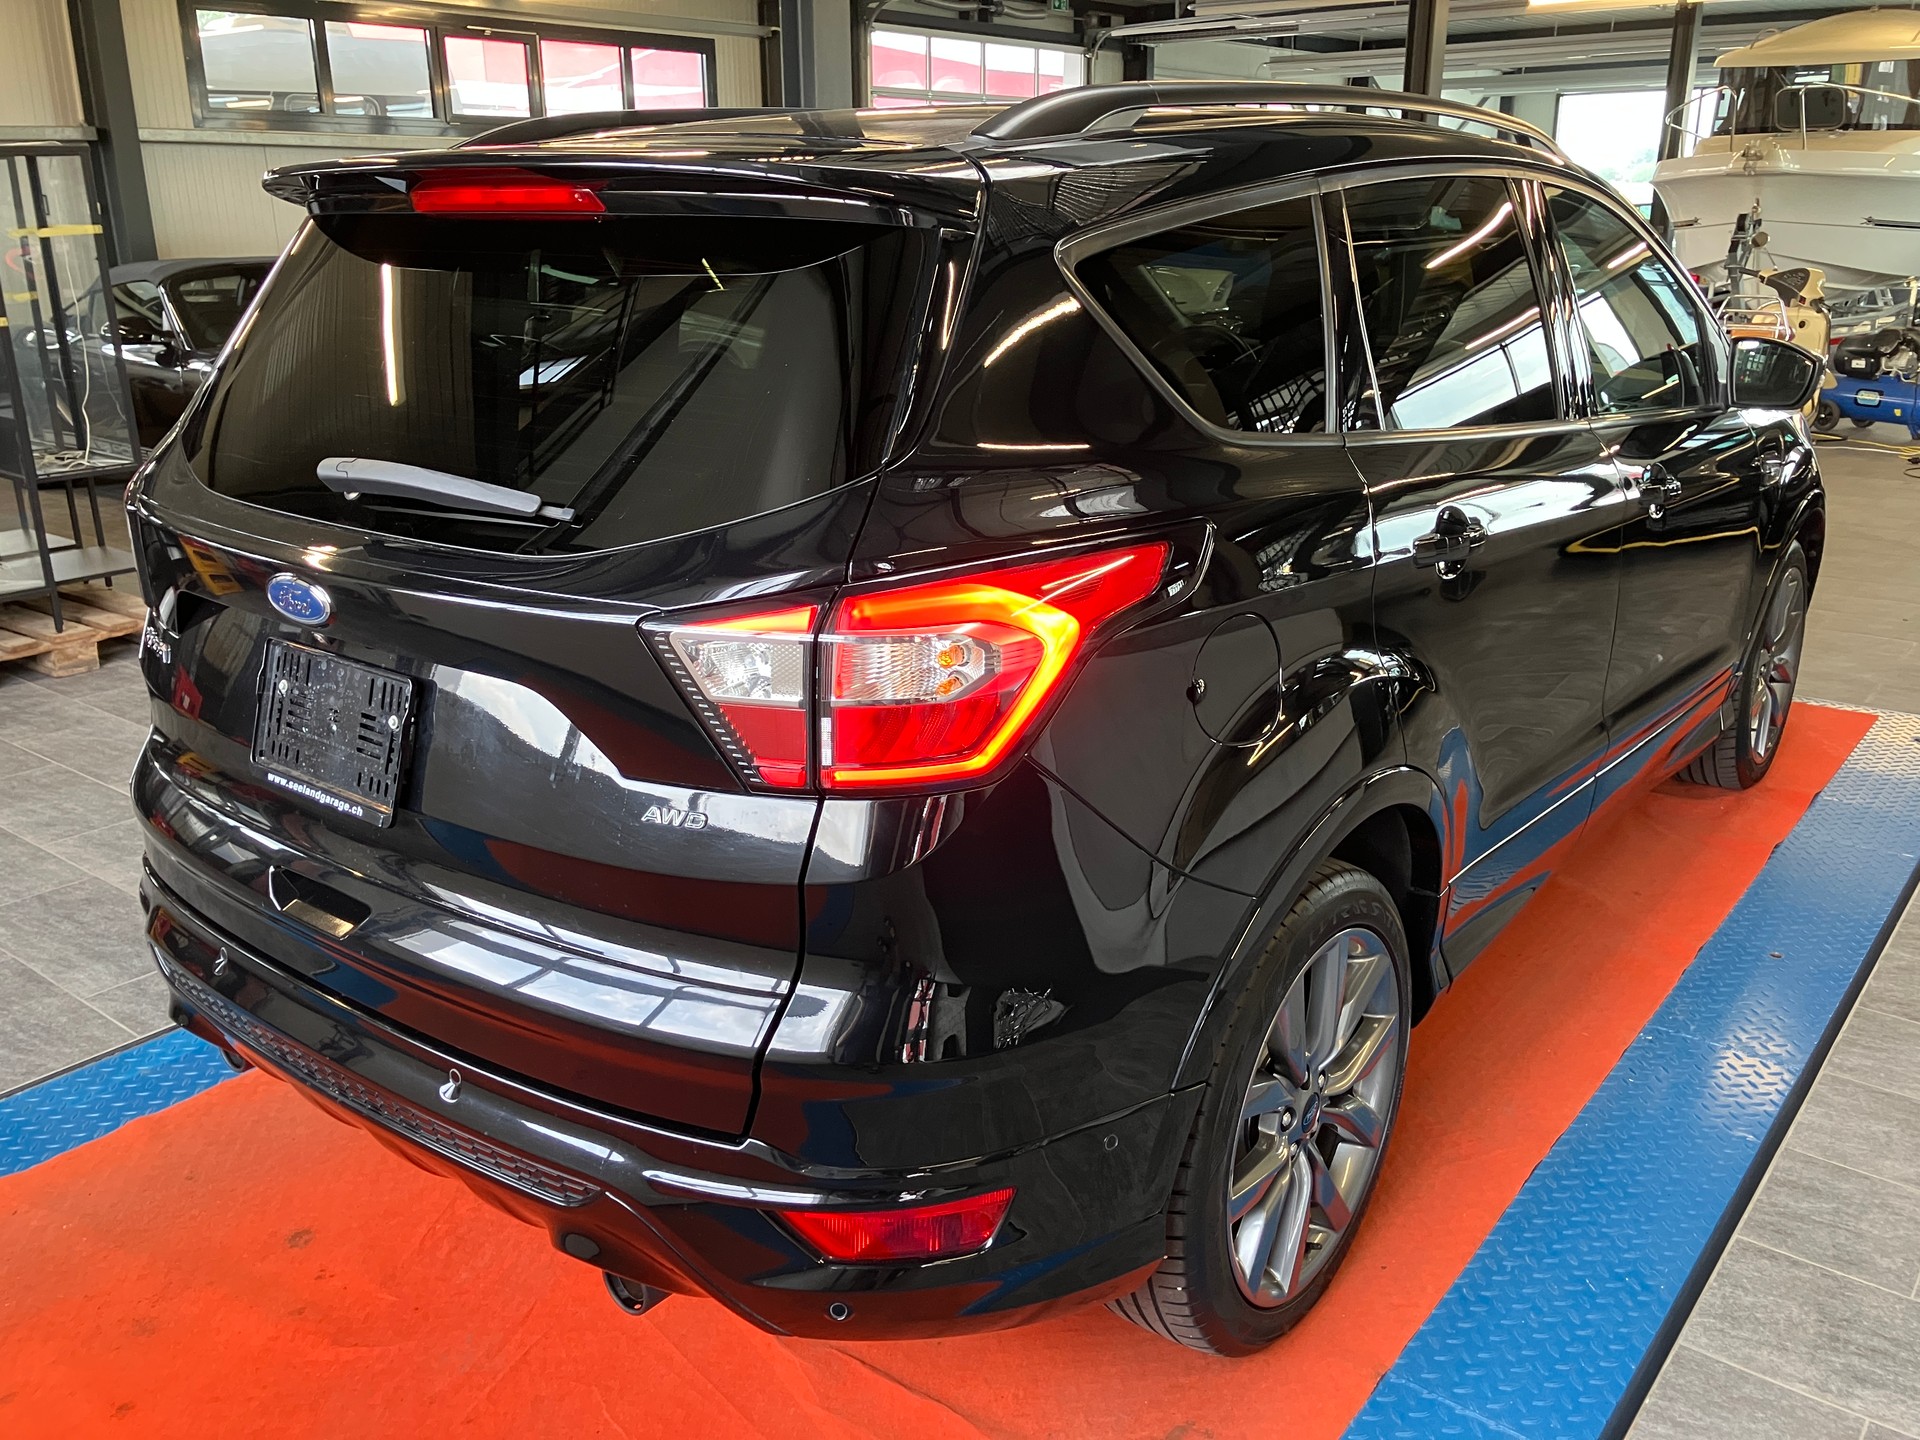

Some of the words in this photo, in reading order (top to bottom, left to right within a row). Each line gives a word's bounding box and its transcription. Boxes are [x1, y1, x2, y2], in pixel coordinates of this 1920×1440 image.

[279, 585, 312, 615] Ford
[267, 772, 363, 817] www.seelandgarage.ch
[641, 804, 709, 830] AWD
